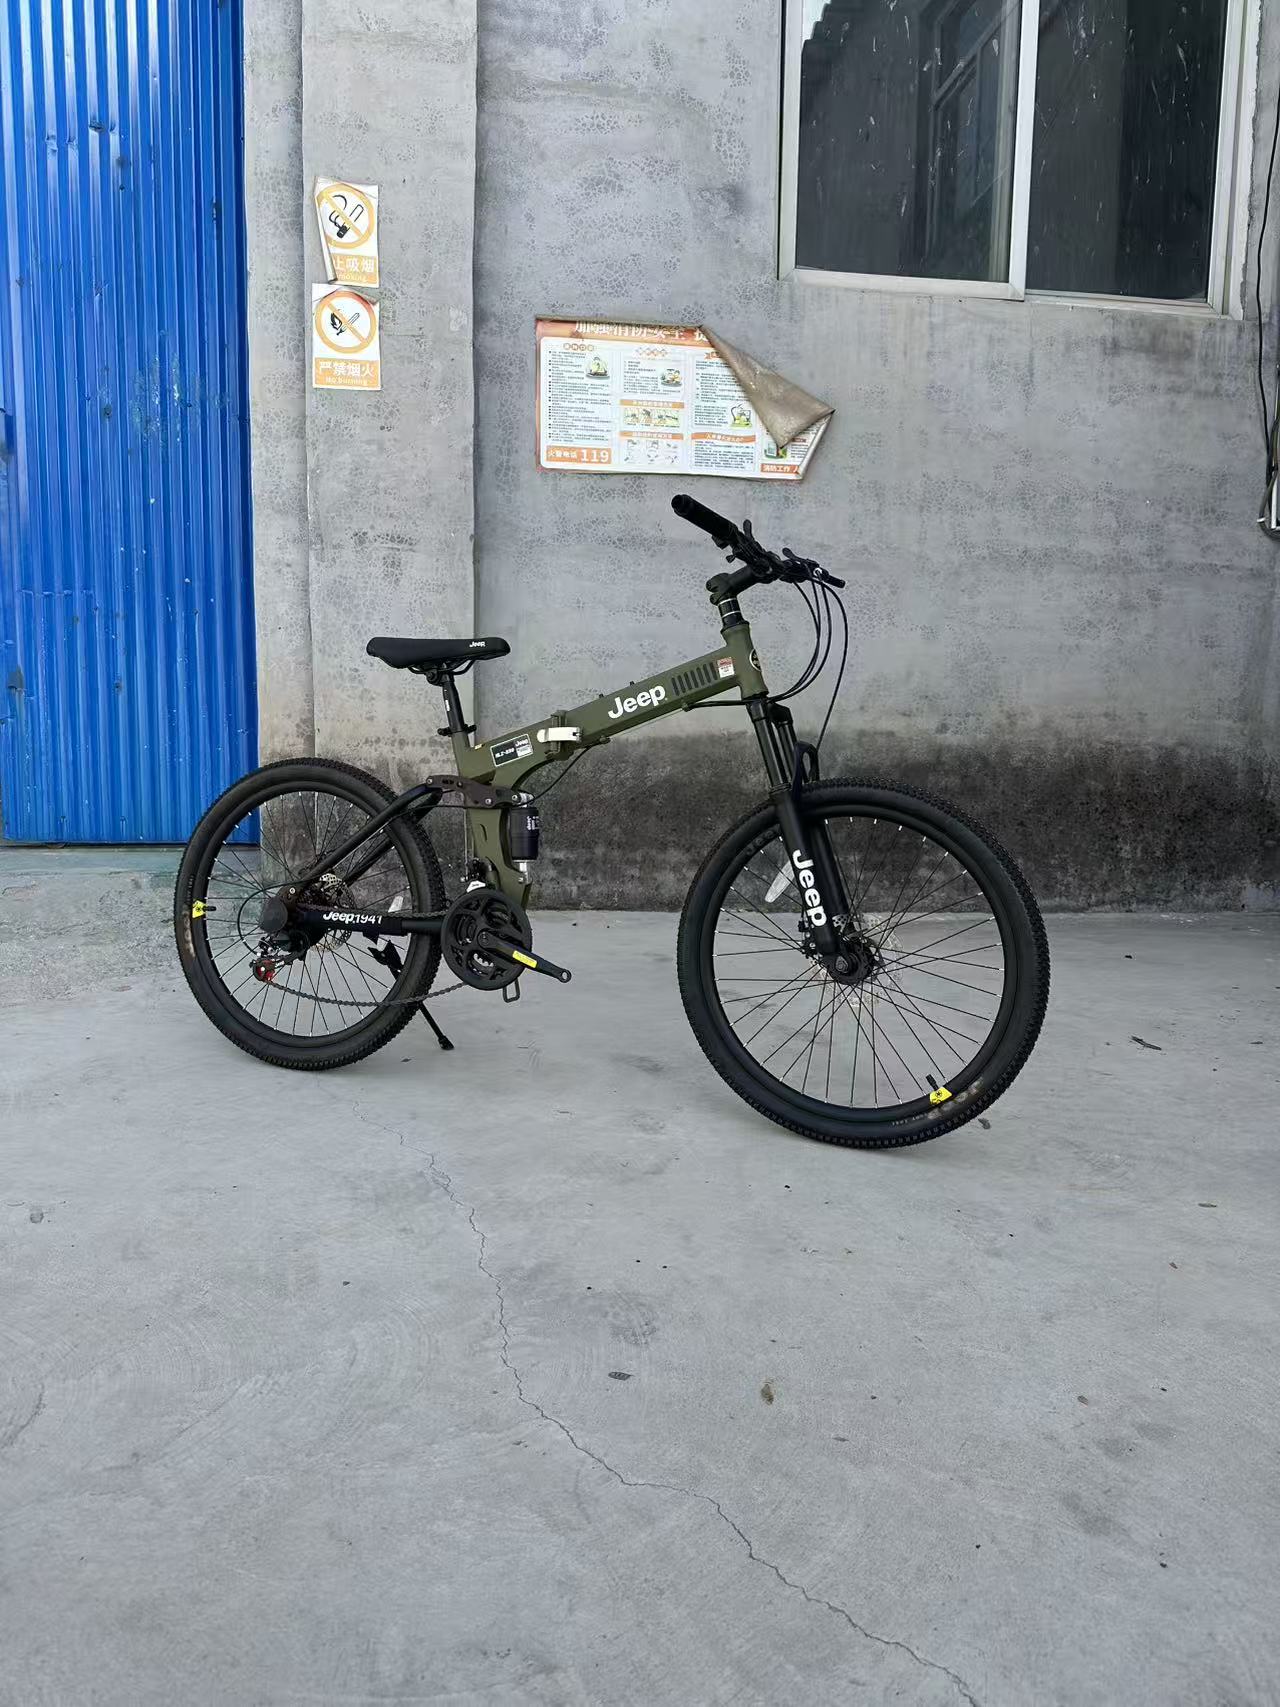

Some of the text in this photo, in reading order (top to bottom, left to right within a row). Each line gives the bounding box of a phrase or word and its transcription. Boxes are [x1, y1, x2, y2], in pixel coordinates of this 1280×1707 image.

[318, 361, 375, 377] 严禁烟火
[580, 448, 609, 463] 119
[608, 685, 666, 719] Jeep
[792, 849, 827, 928] Jeep
